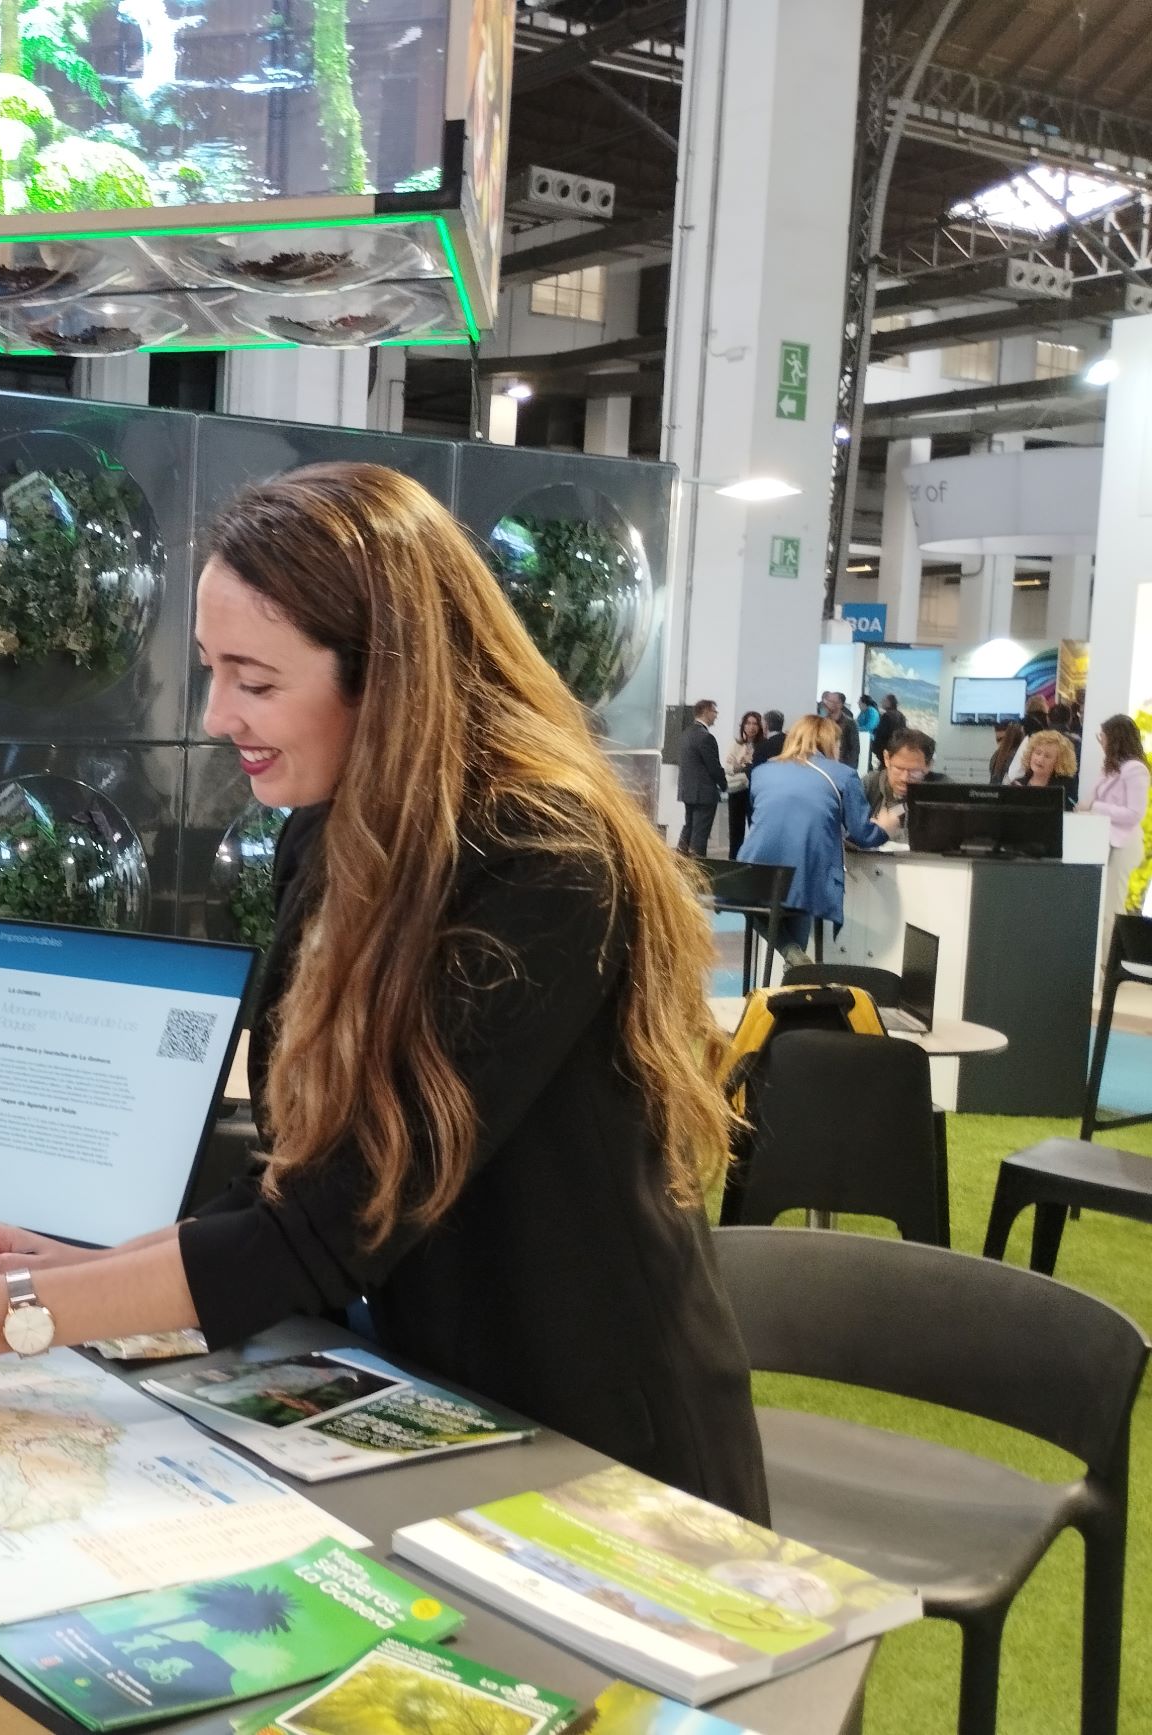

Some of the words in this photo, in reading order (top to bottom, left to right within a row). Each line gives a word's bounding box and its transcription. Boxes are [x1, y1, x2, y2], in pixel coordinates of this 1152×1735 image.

[925, 480, 948, 504] of
[294, 1564, 322, 1584] La
[319, 1580, 396, 1630] Gomera
